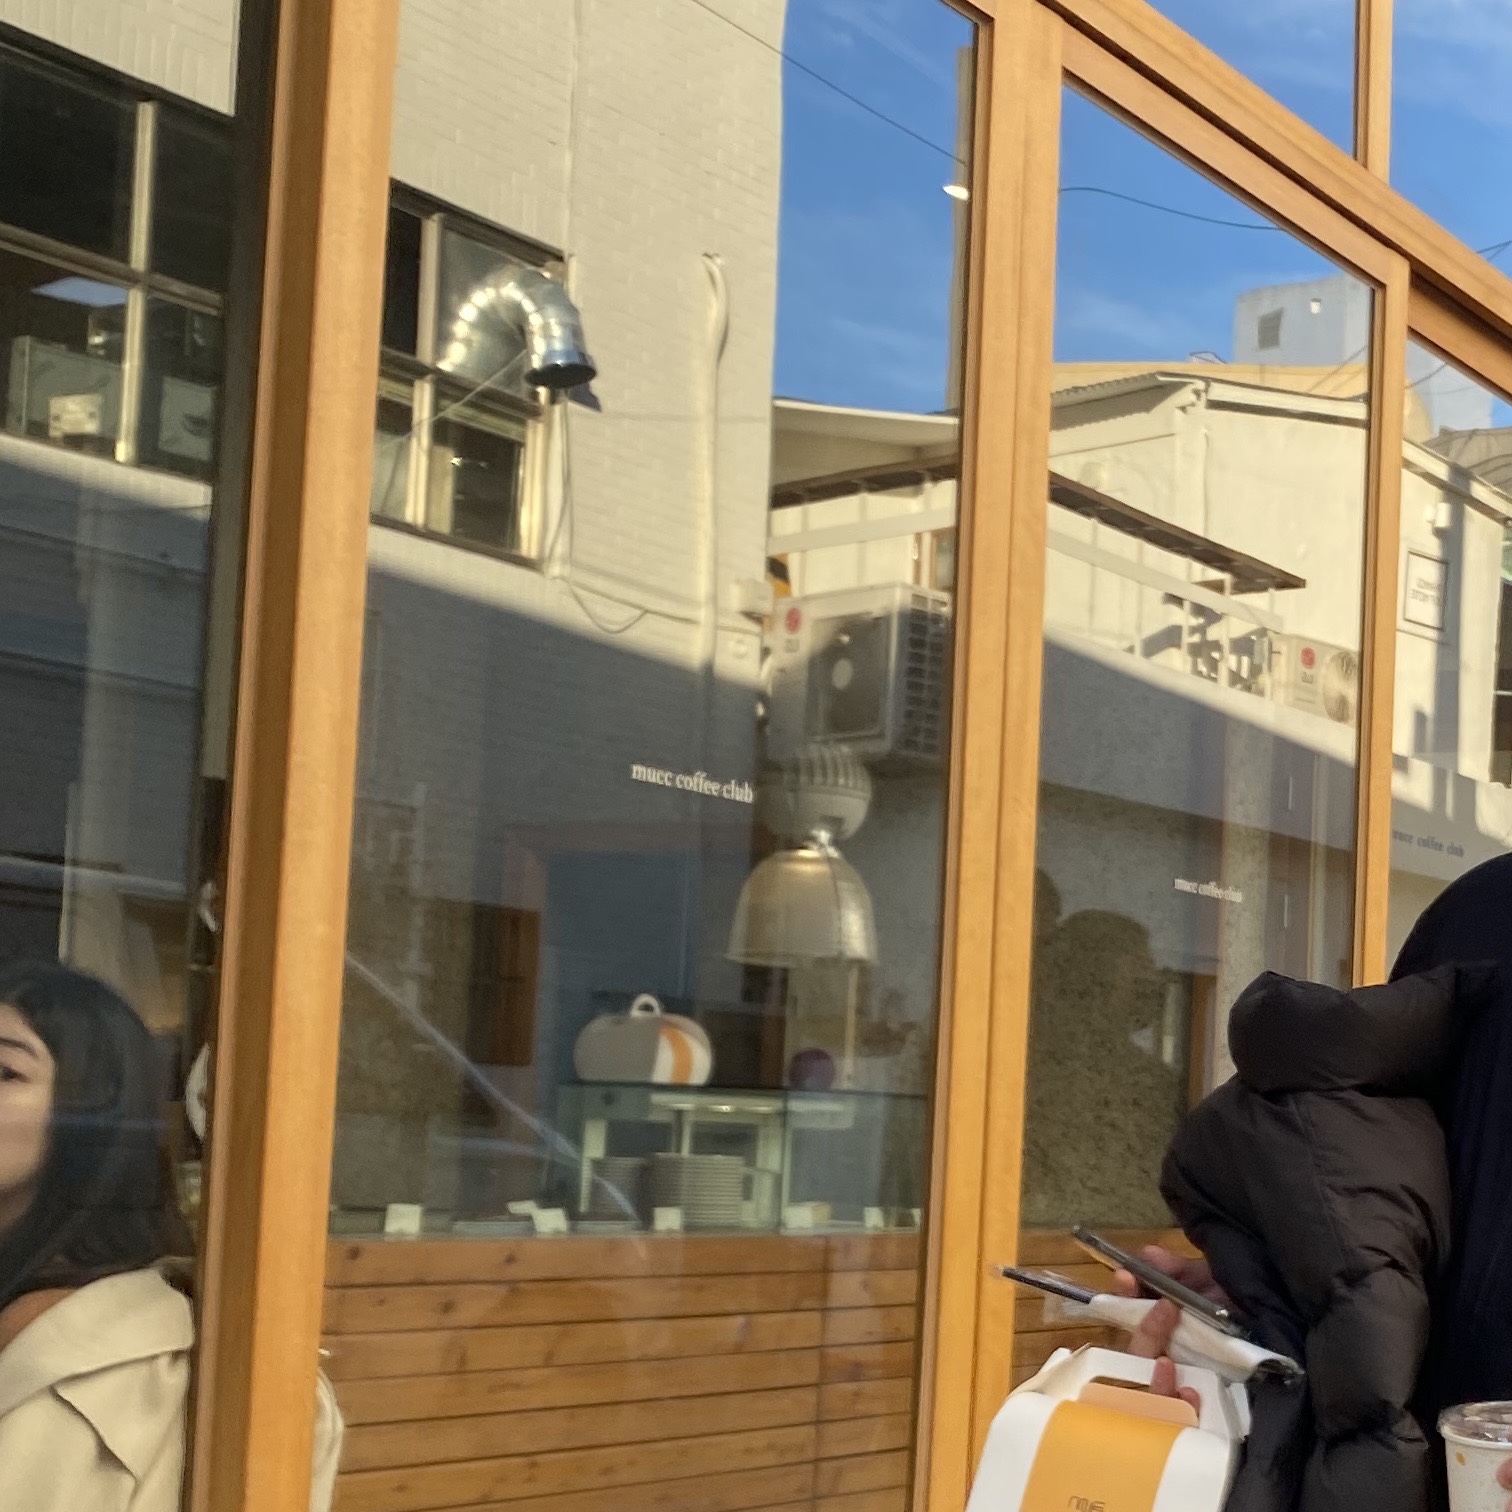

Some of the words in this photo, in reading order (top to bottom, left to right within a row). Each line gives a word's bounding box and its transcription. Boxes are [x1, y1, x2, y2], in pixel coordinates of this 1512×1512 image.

[631, 764, 673, 787] mucc
[675, 771, 721, 796] coffee
[723, 779, 753, 804] club
